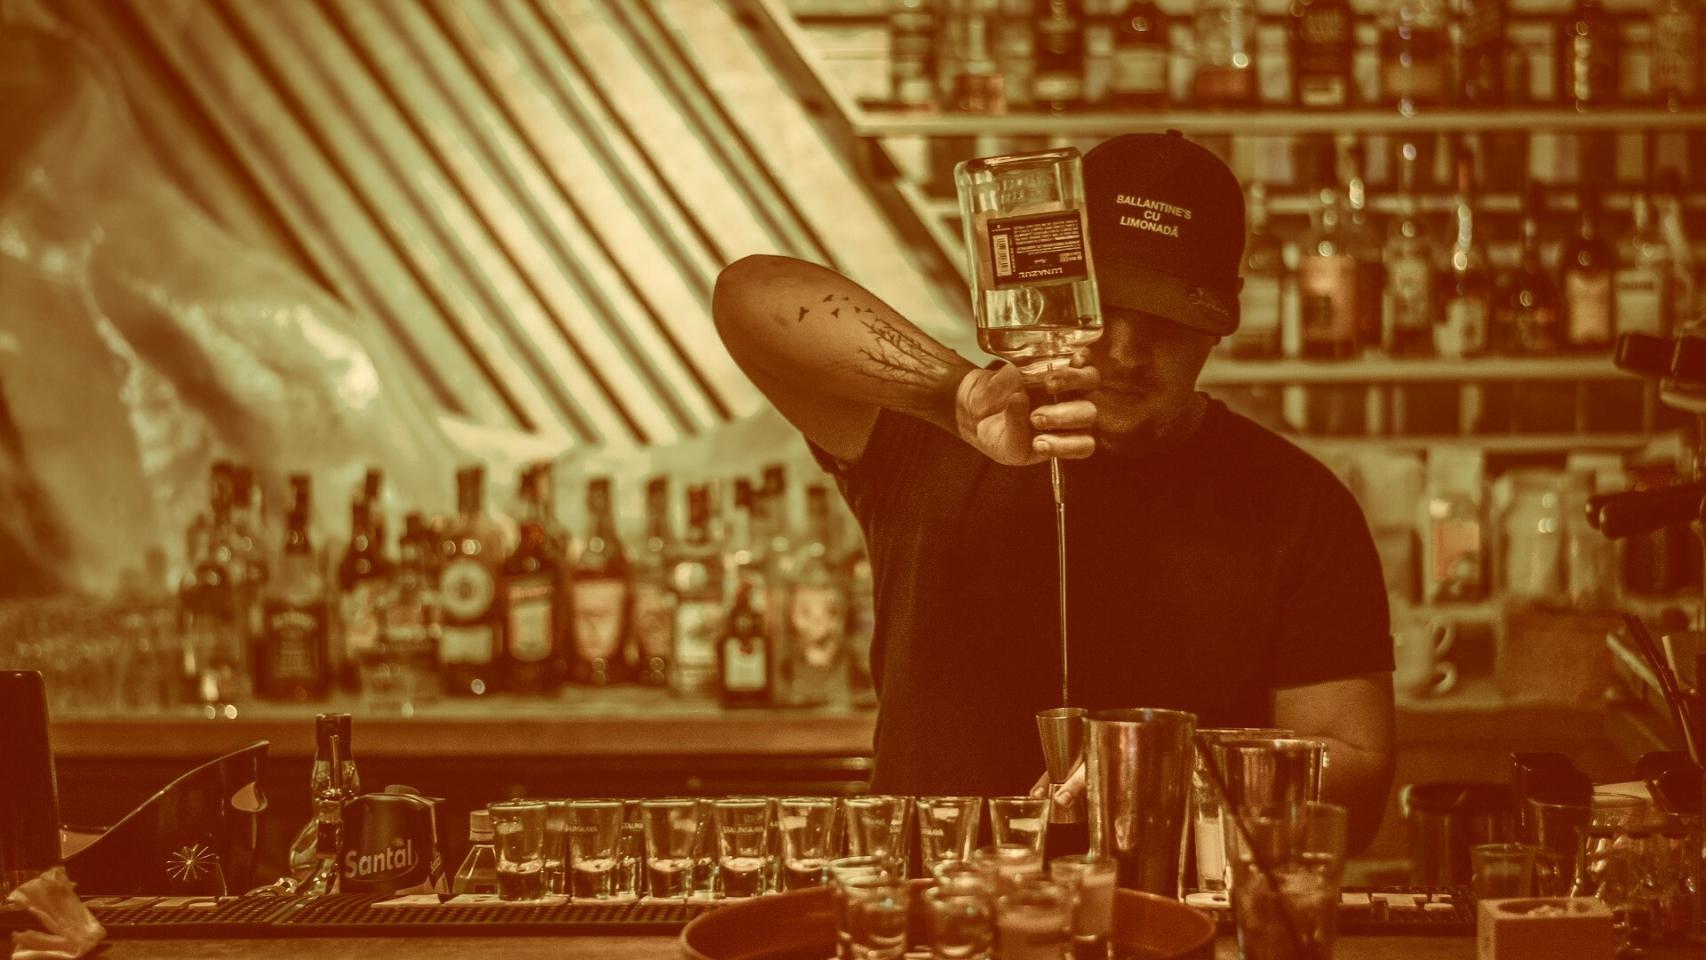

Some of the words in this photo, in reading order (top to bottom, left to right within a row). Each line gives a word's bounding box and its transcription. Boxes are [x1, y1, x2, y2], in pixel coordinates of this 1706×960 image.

[1116, 194, 1192, 219] BALLANTINE'S
[1144, 210, 1161, 221] CU
[1018, 267, 1063, 278] LUNAZUL
